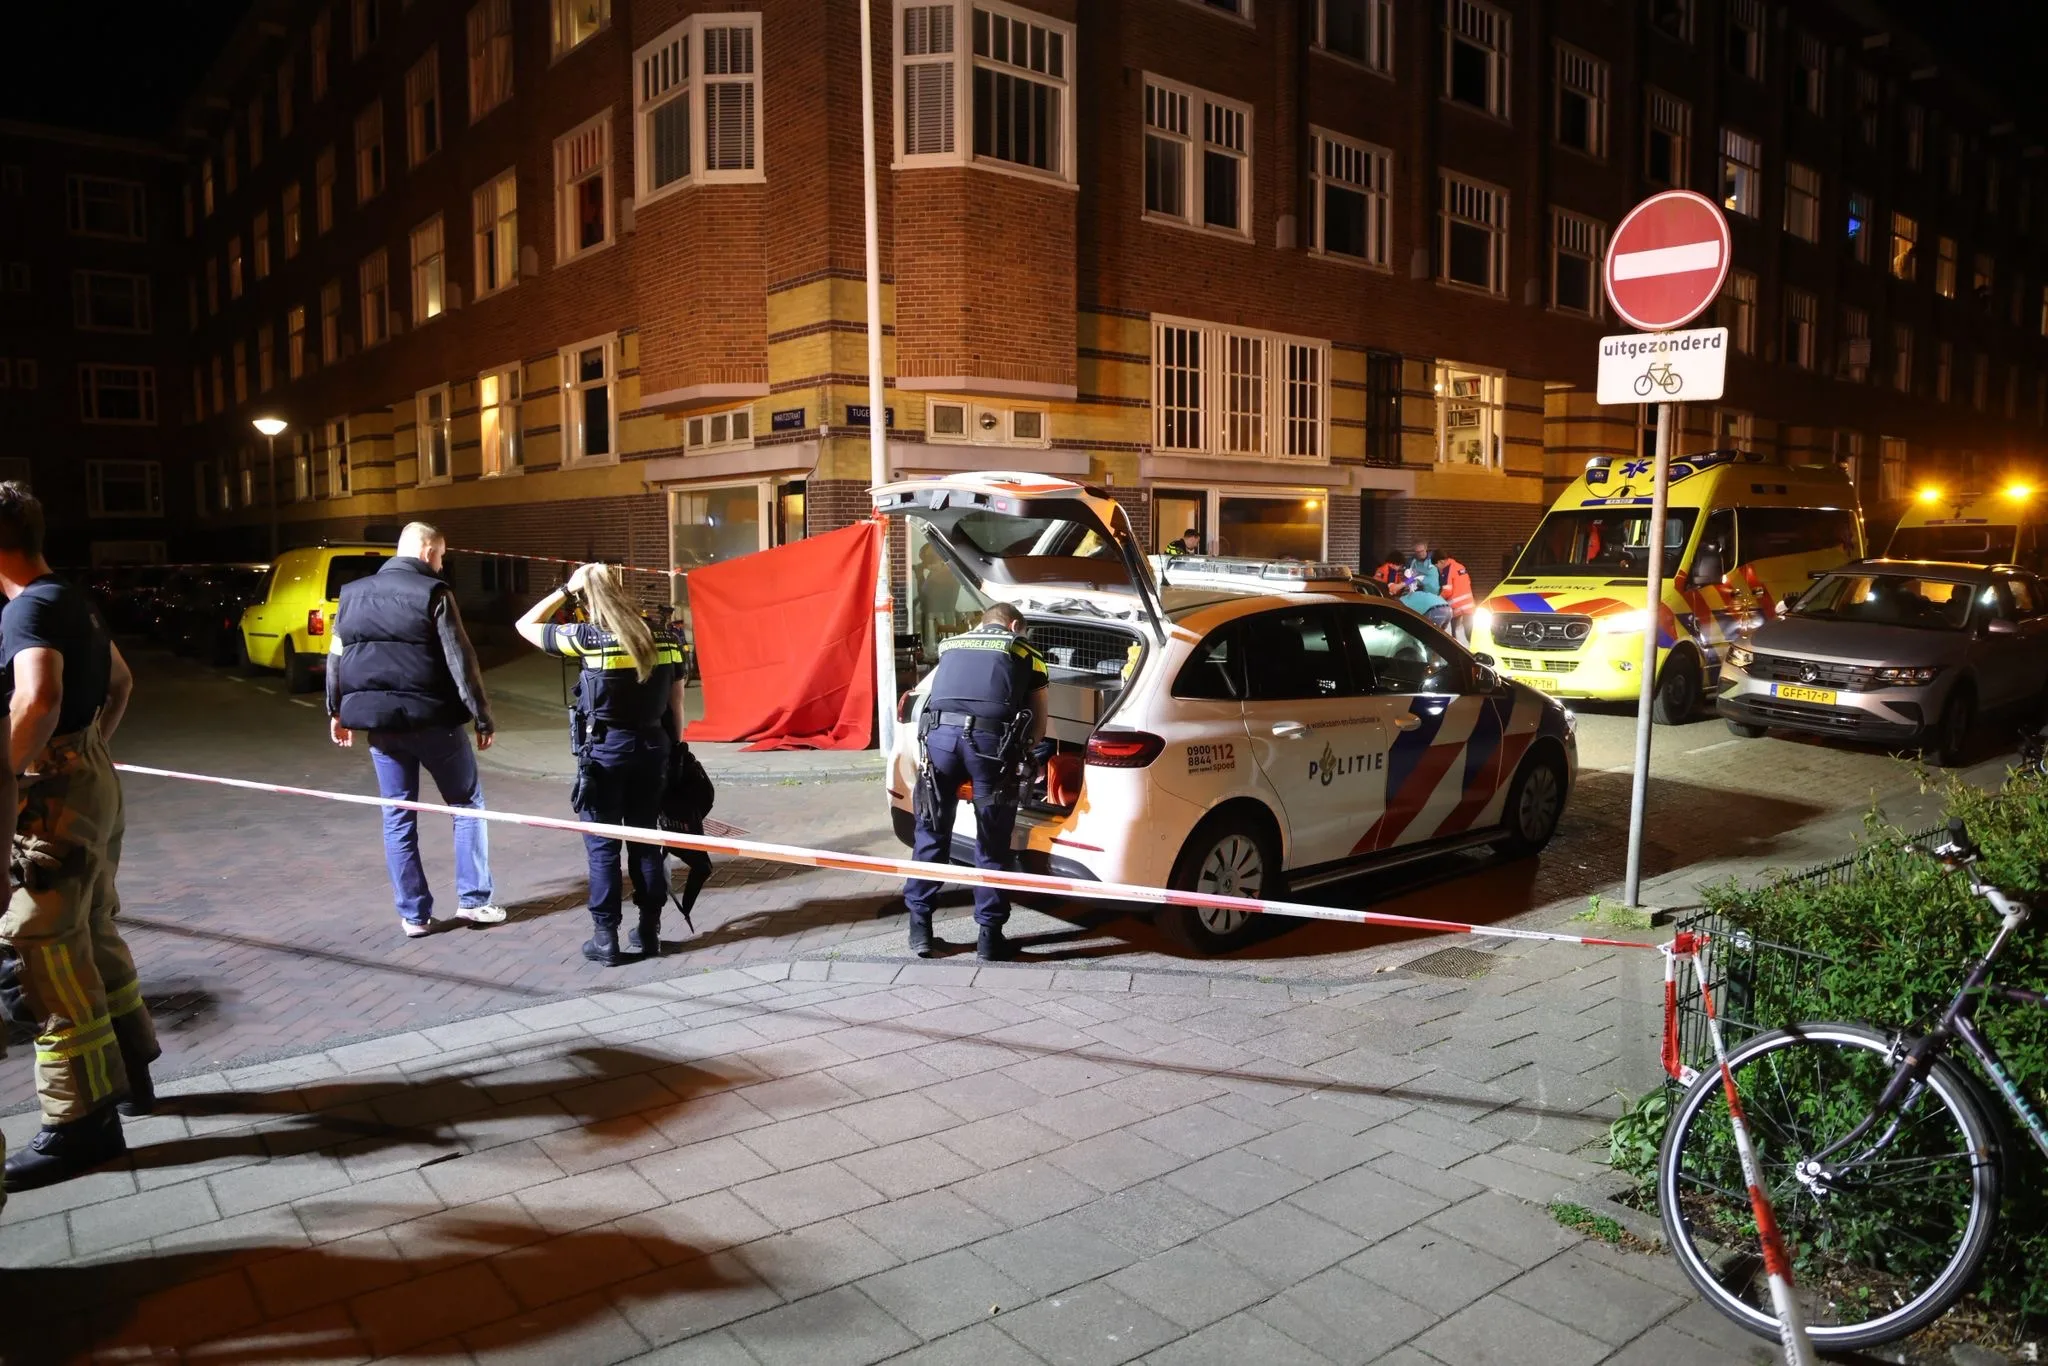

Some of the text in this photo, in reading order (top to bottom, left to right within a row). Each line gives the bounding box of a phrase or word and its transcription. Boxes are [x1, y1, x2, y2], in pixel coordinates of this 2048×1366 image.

[1604, 333, 1721, 359] uitgezonderd
[1782, 687, 1829, 701] GFF-17-P
[1187, 745, 1211, 756] 0900
[1211, 743, 1235, 760] 112
[1188, 756, 1211, 766] 8844
[1213, 760, 1235, 772] spoed
[1309, 752, 1383, 786] POLITIE
